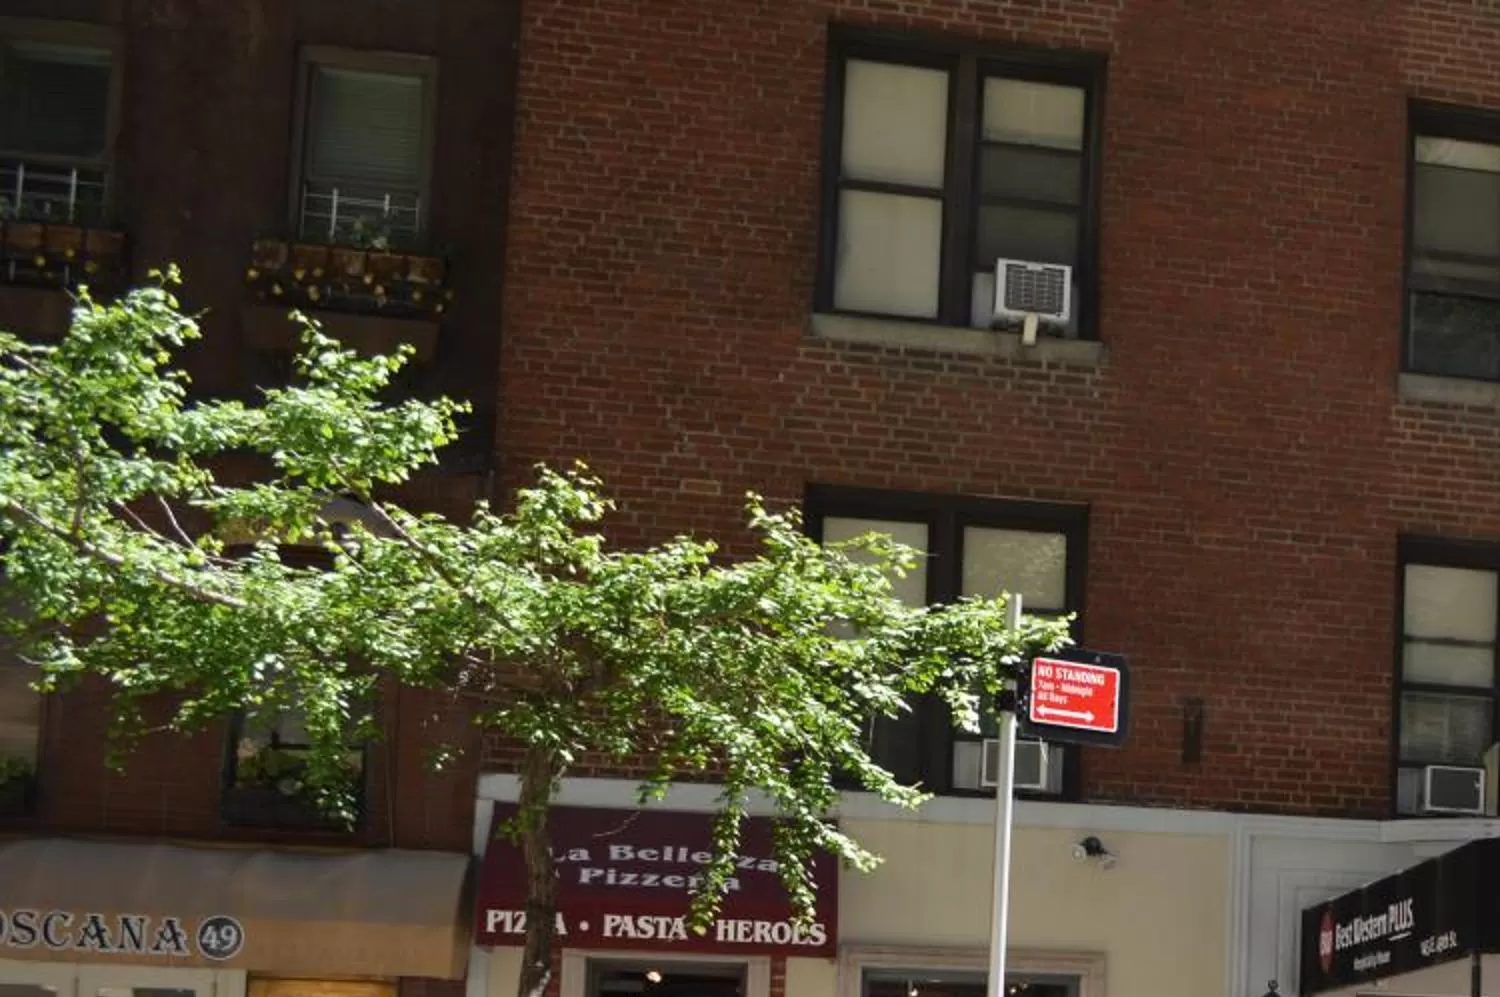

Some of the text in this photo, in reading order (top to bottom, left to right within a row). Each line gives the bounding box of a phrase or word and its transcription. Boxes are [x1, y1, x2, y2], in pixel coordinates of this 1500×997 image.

[1037, 664, 1105, 686] NO STANDING
[608, 844, 780, 873] Belleza
[579, 867, 741, 891] Pizzera
[202, 925, 239, 951] 49
[486, 908, 828, 946] PIZA PASTA HEROES
[1335, 922, 1353, 951] Best
[1353, 914, 1388, 945] Western
[1387, 898, 1415, 933] PLUS
